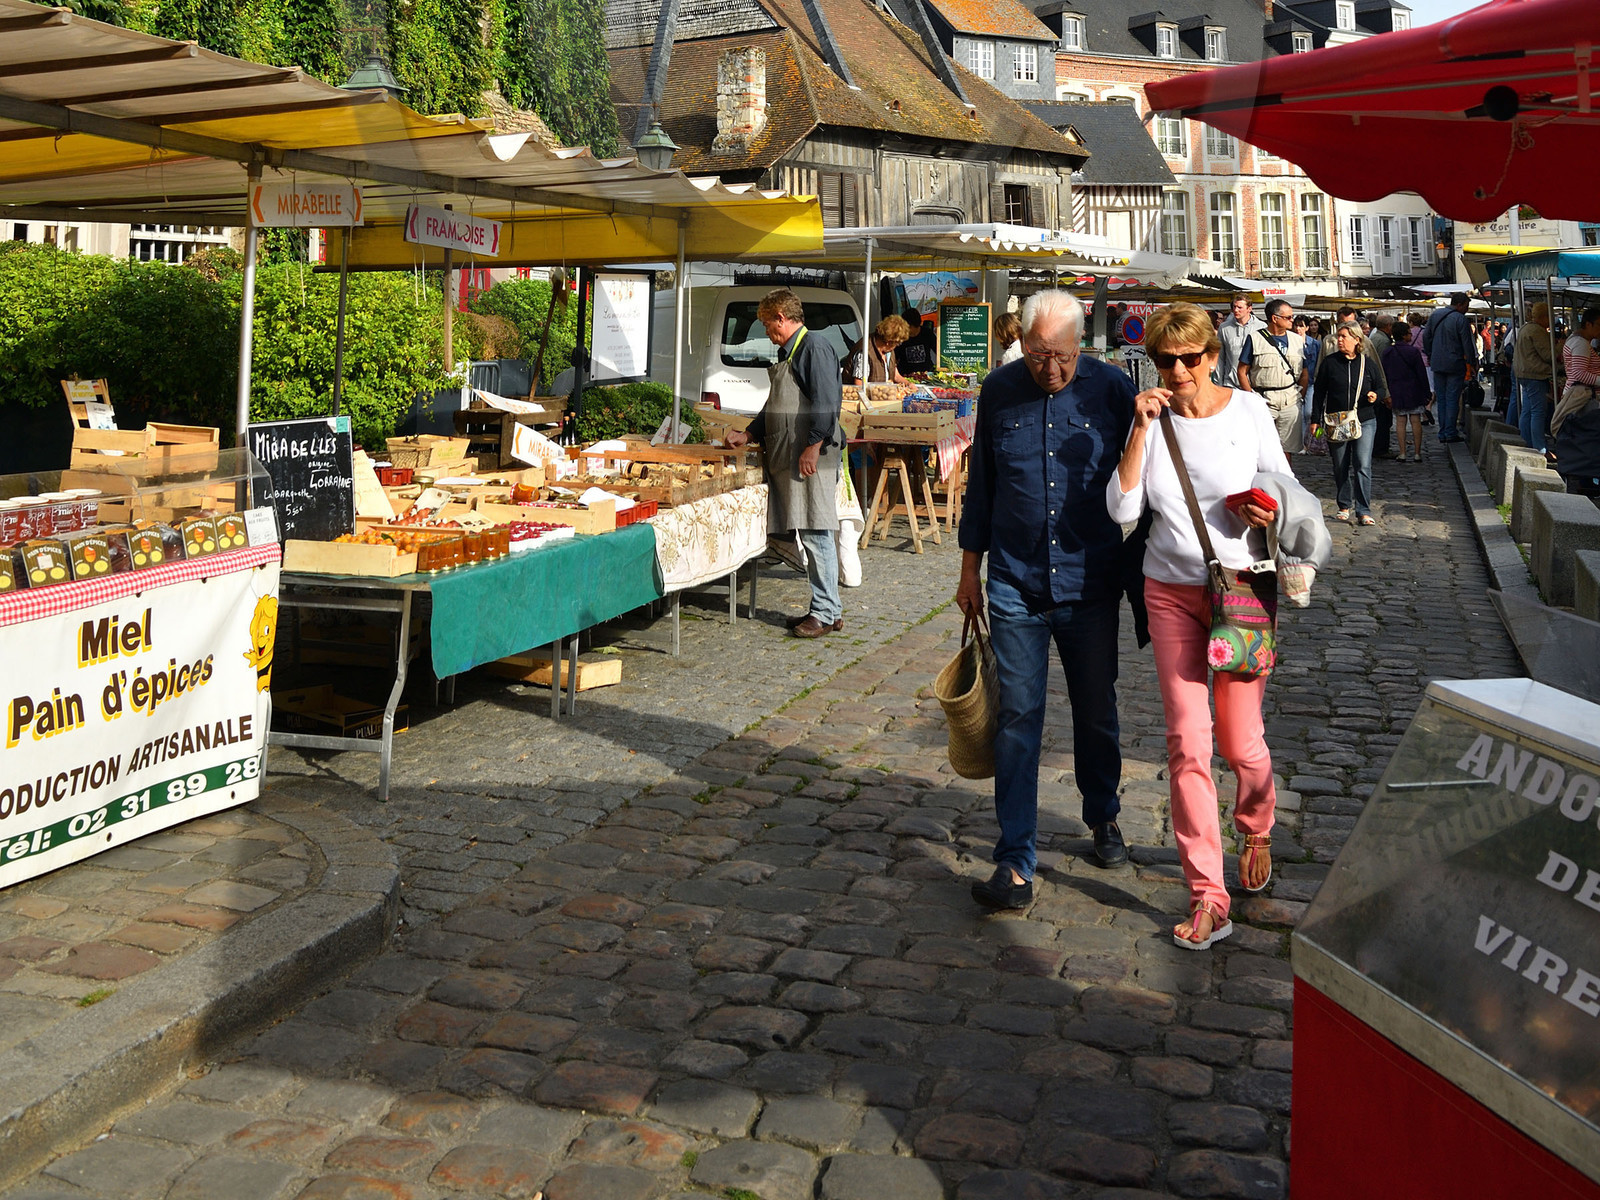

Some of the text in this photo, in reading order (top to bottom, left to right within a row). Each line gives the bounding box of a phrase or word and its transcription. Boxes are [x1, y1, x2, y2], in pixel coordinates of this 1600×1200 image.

[277, 193, 342, 215] MIRABELLE
[426, 217, 485, 246] FRAMOISE
[1489, 221, 1537, 232] Corire
[79, 608, 152, 667] Miel
[6, 654, 214, 749] Pain d'épices
[0, 714, 253, 820] ODUCTION ARTISANALE
[68, 808, 108, 837] 02
[120, 789, 151, 819] 31
[167, 773, 207, 803] 89
[225, 756, 259, 785] 28
[1456, 733, 1600, 832] ANDO
[1474, 914, 1600, 1018] VIRE
